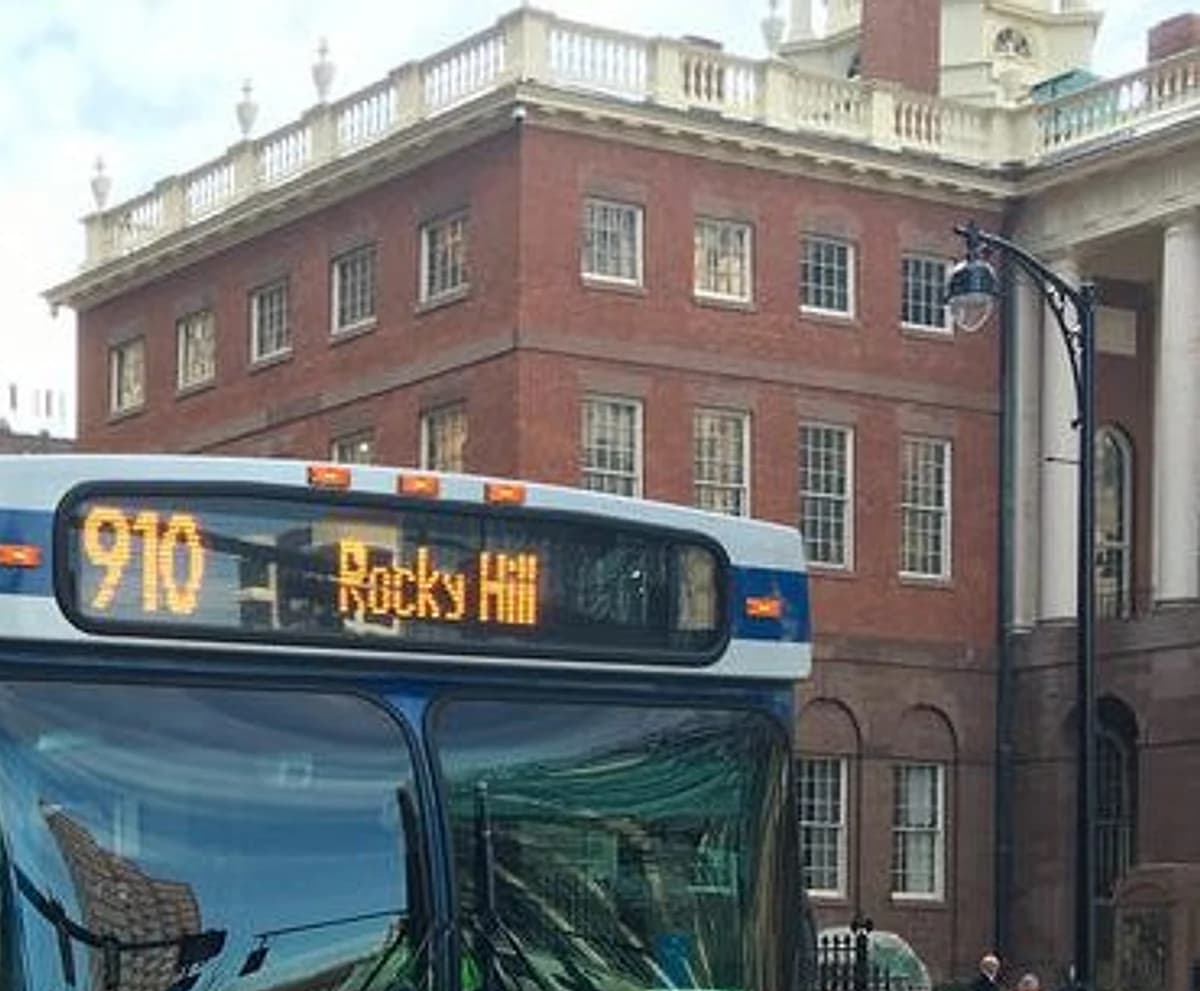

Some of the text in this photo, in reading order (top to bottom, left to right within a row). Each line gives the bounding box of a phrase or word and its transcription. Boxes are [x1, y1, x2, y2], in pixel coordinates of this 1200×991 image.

[84, 505, 537, 625] 910 Rocky Hill
